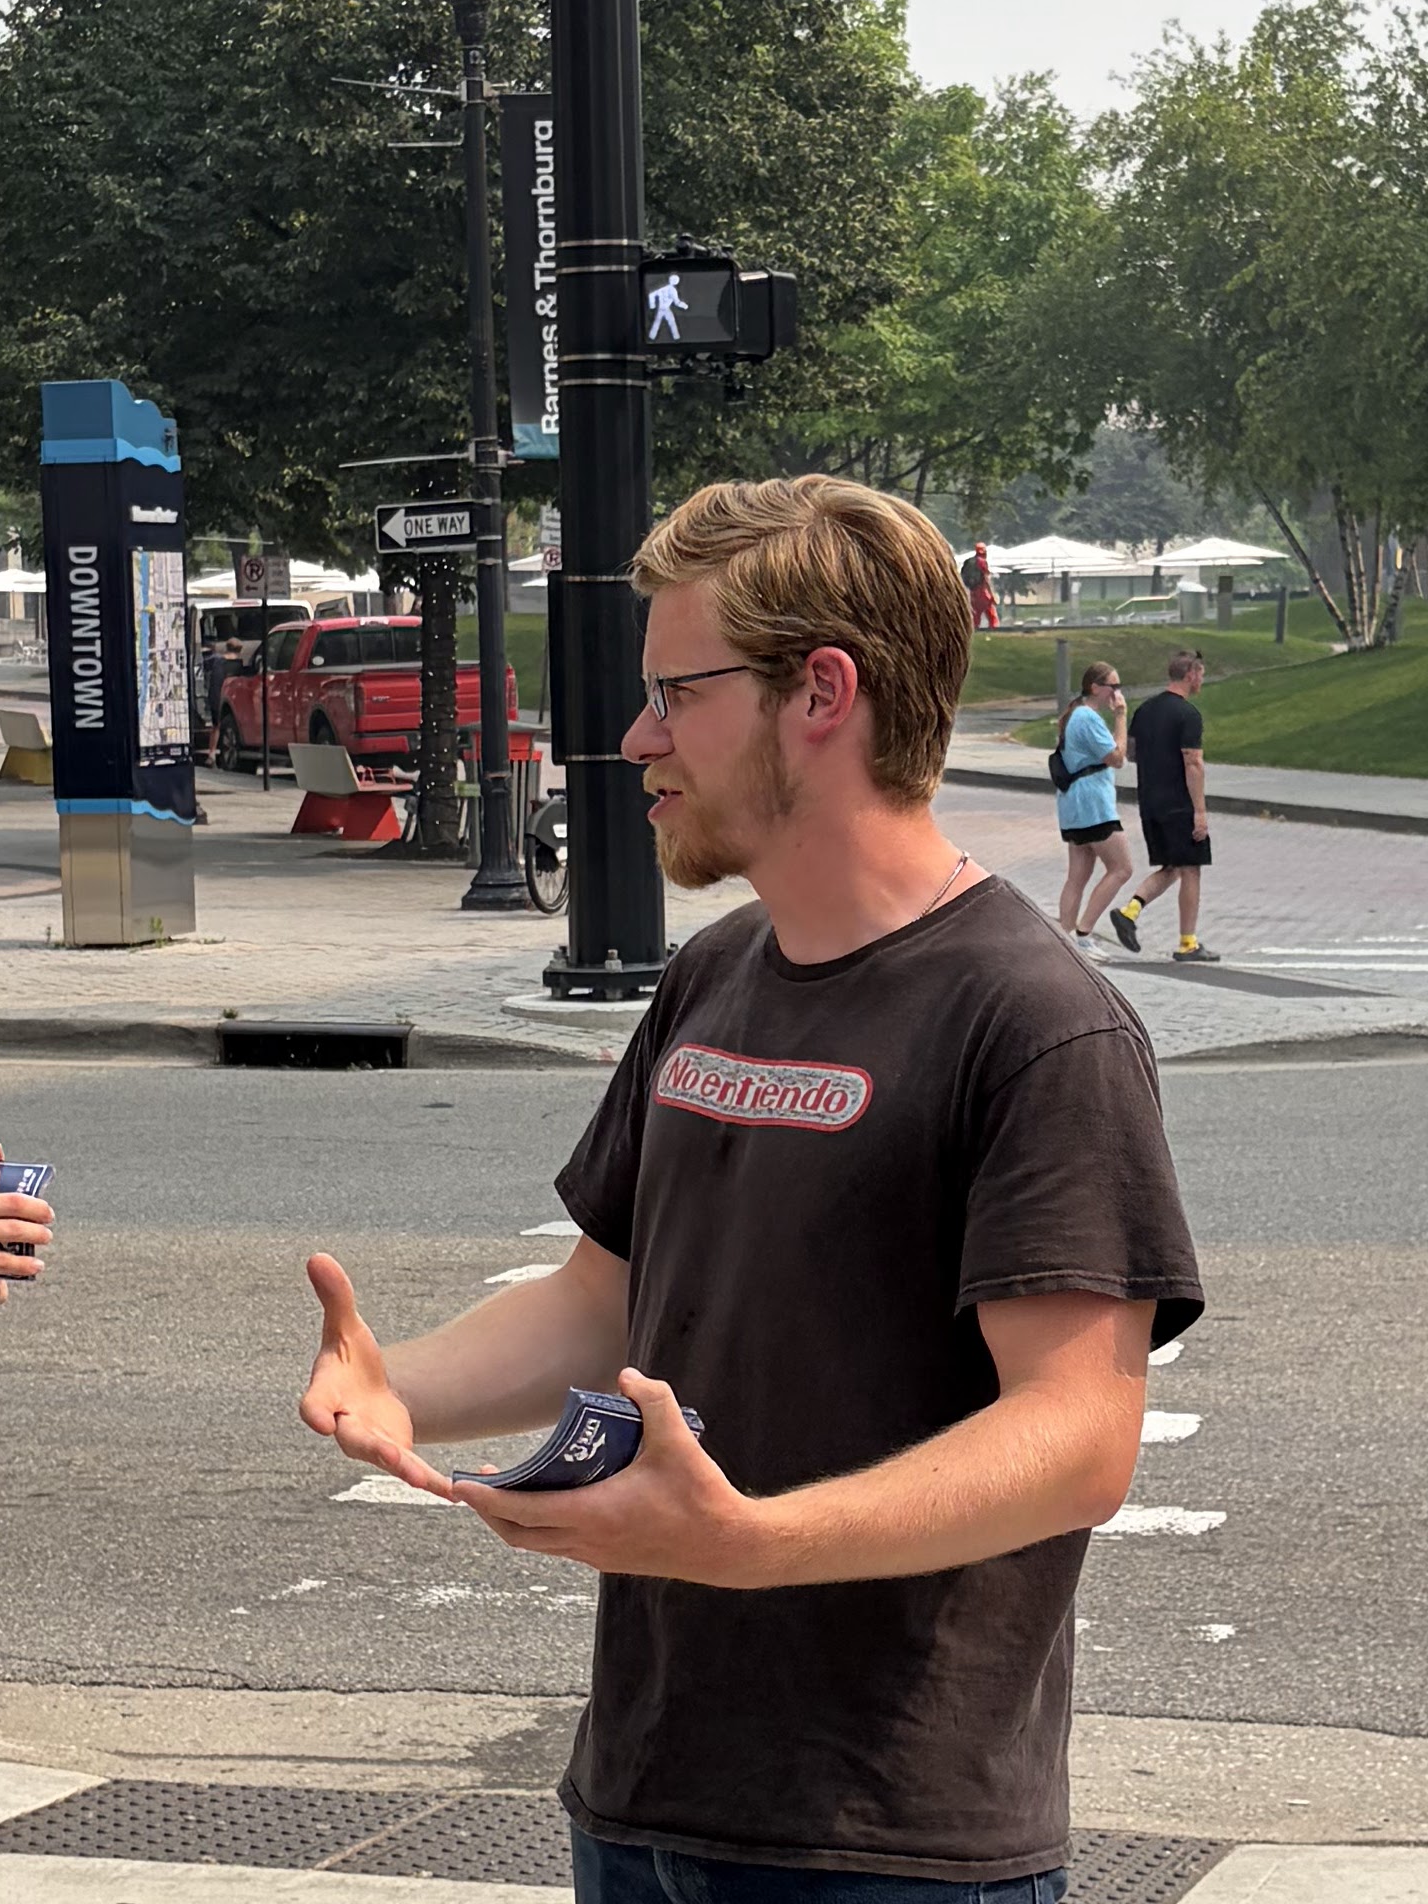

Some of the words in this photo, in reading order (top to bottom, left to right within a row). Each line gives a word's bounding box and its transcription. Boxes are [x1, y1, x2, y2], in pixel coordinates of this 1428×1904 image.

[404, 517, 434, 537] ONE
[437, 515, 466, 535] WAY
[68, 545, 105, 729] DOWNTOWN
[666, 1056, 701, 1092] No
[700, 1072, 849, 1115] entiendo
